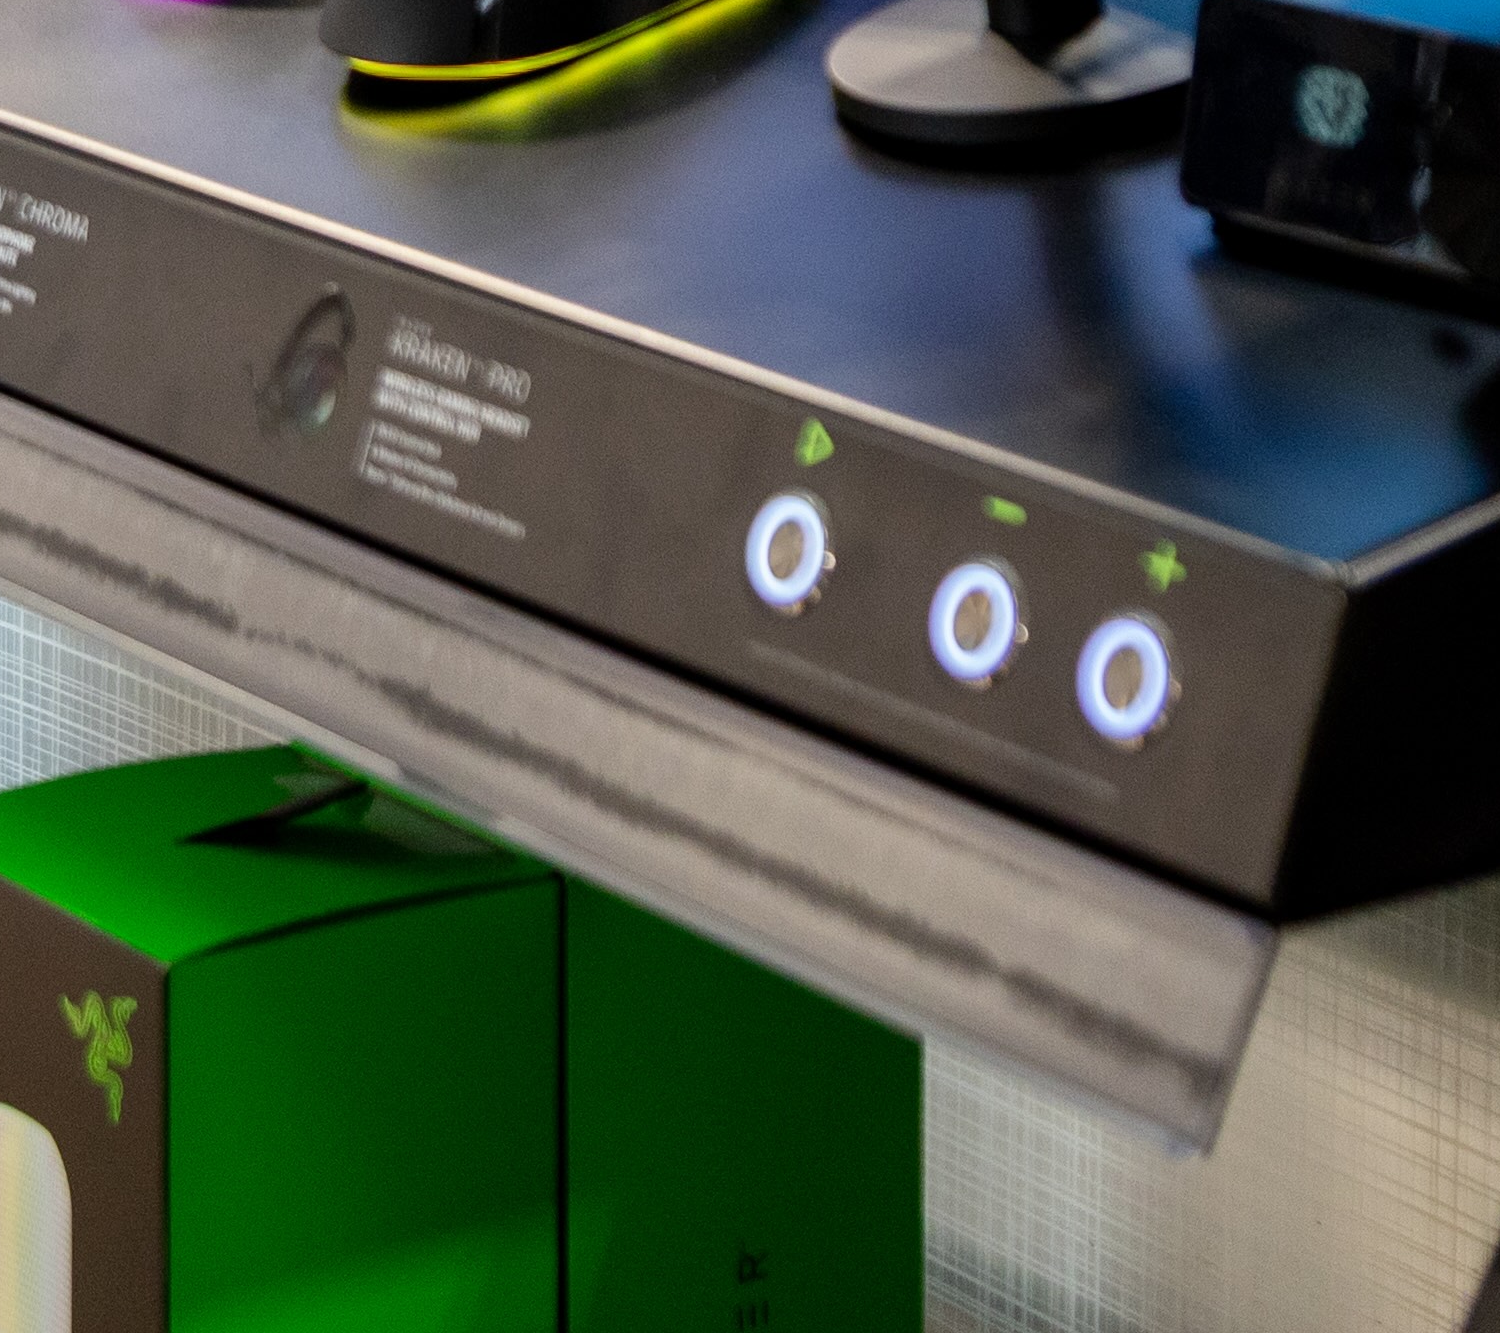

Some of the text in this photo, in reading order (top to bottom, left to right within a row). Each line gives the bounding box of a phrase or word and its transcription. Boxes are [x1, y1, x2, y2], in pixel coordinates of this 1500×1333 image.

[16, 192, 90, 245] CHROMA
[387, 330, 532, 407] KRAKEN PRO
